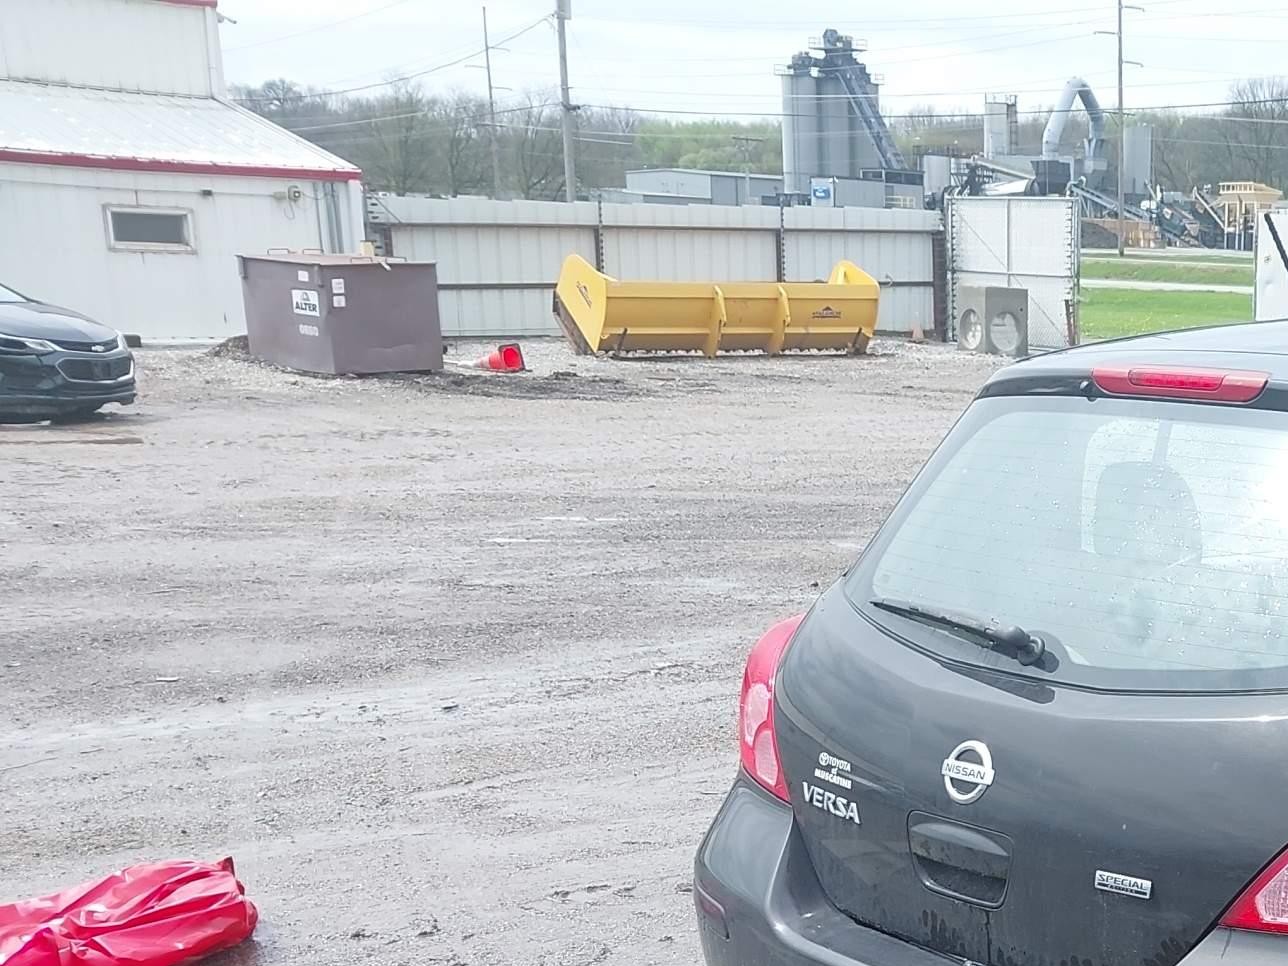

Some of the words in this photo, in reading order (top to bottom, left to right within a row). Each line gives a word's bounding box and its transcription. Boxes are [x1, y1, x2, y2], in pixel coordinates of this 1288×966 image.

[295, 301, 317, 312] ALTER
[828, 756, 851, 772] TOYOTA
[945, 763, 986, 780] NISSAN
[802, 781, 861, 825] VERSA
[1098, 874, 1149, 891] SPECIAL
